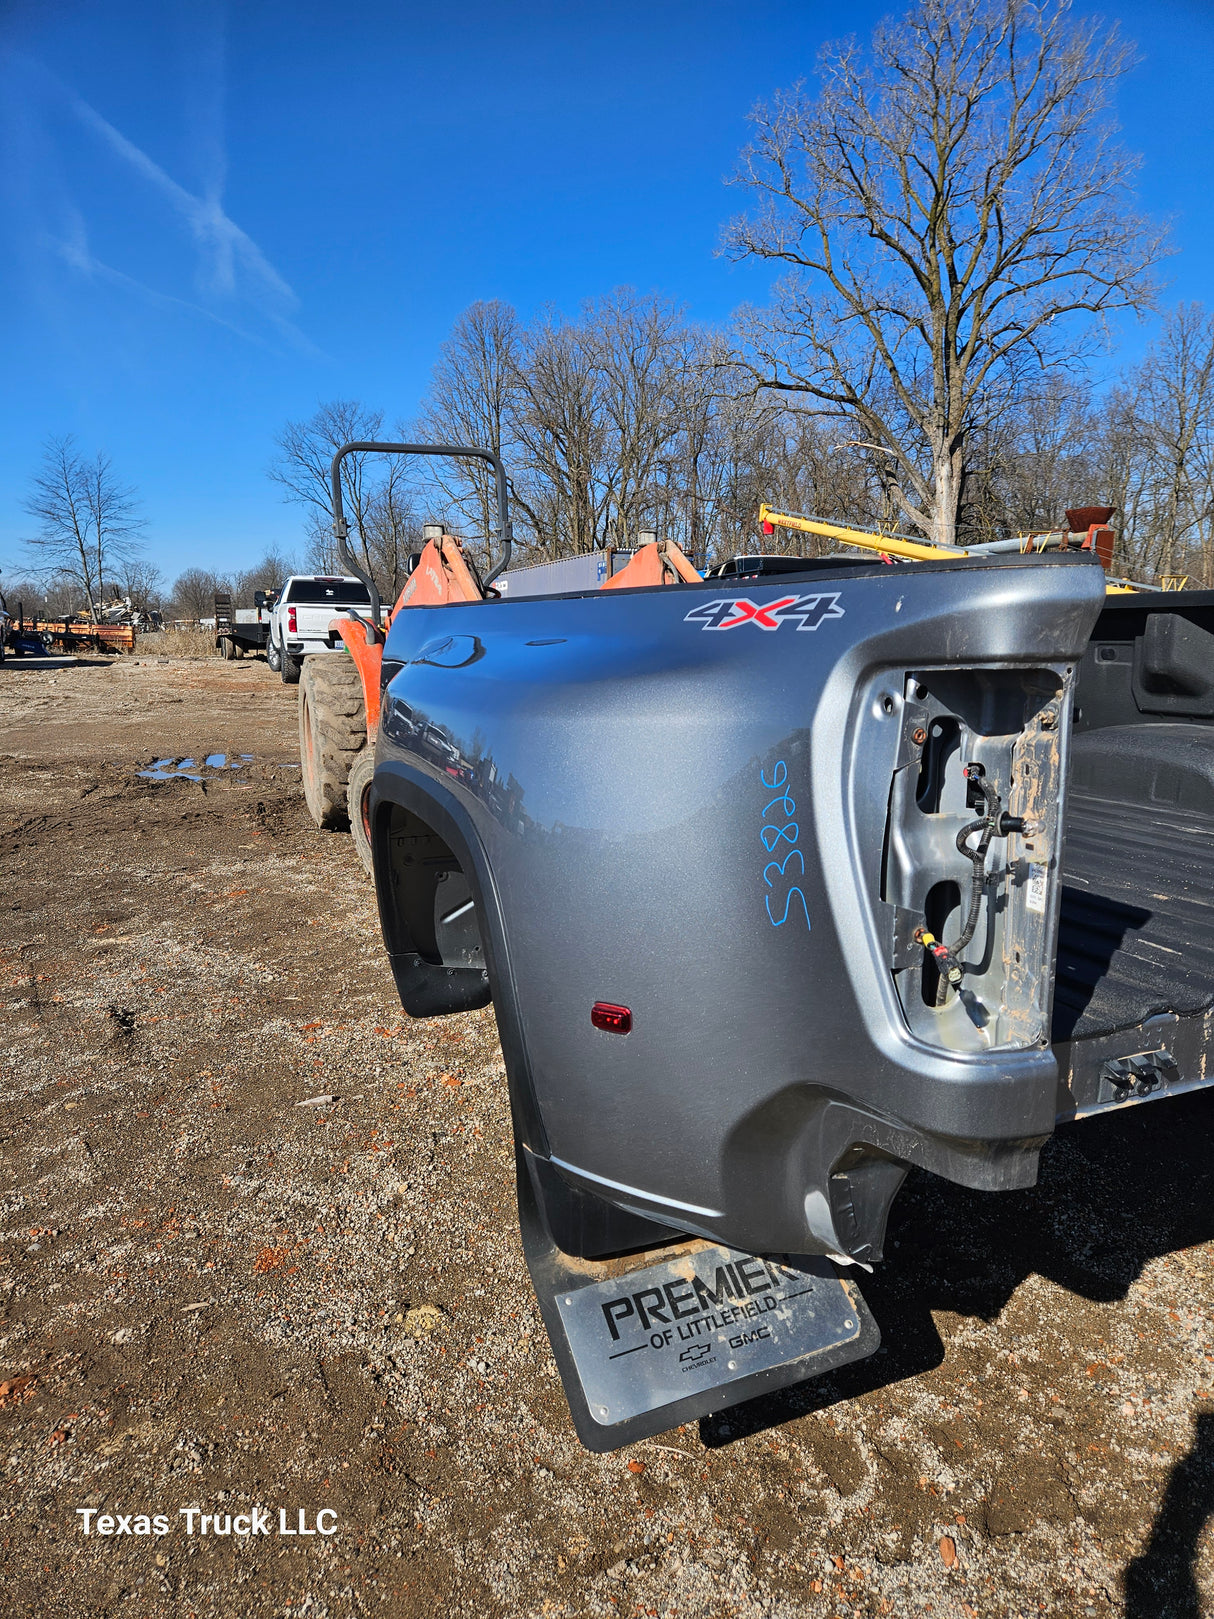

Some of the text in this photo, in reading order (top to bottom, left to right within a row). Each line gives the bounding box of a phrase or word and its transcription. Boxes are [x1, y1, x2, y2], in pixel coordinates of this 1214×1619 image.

[650, 1296, 778, 1350] OF LITTLEFIELD
[728, 1326, 771, 1349] GMC
[681, 1356, 717, 1373] CHEVROLET
